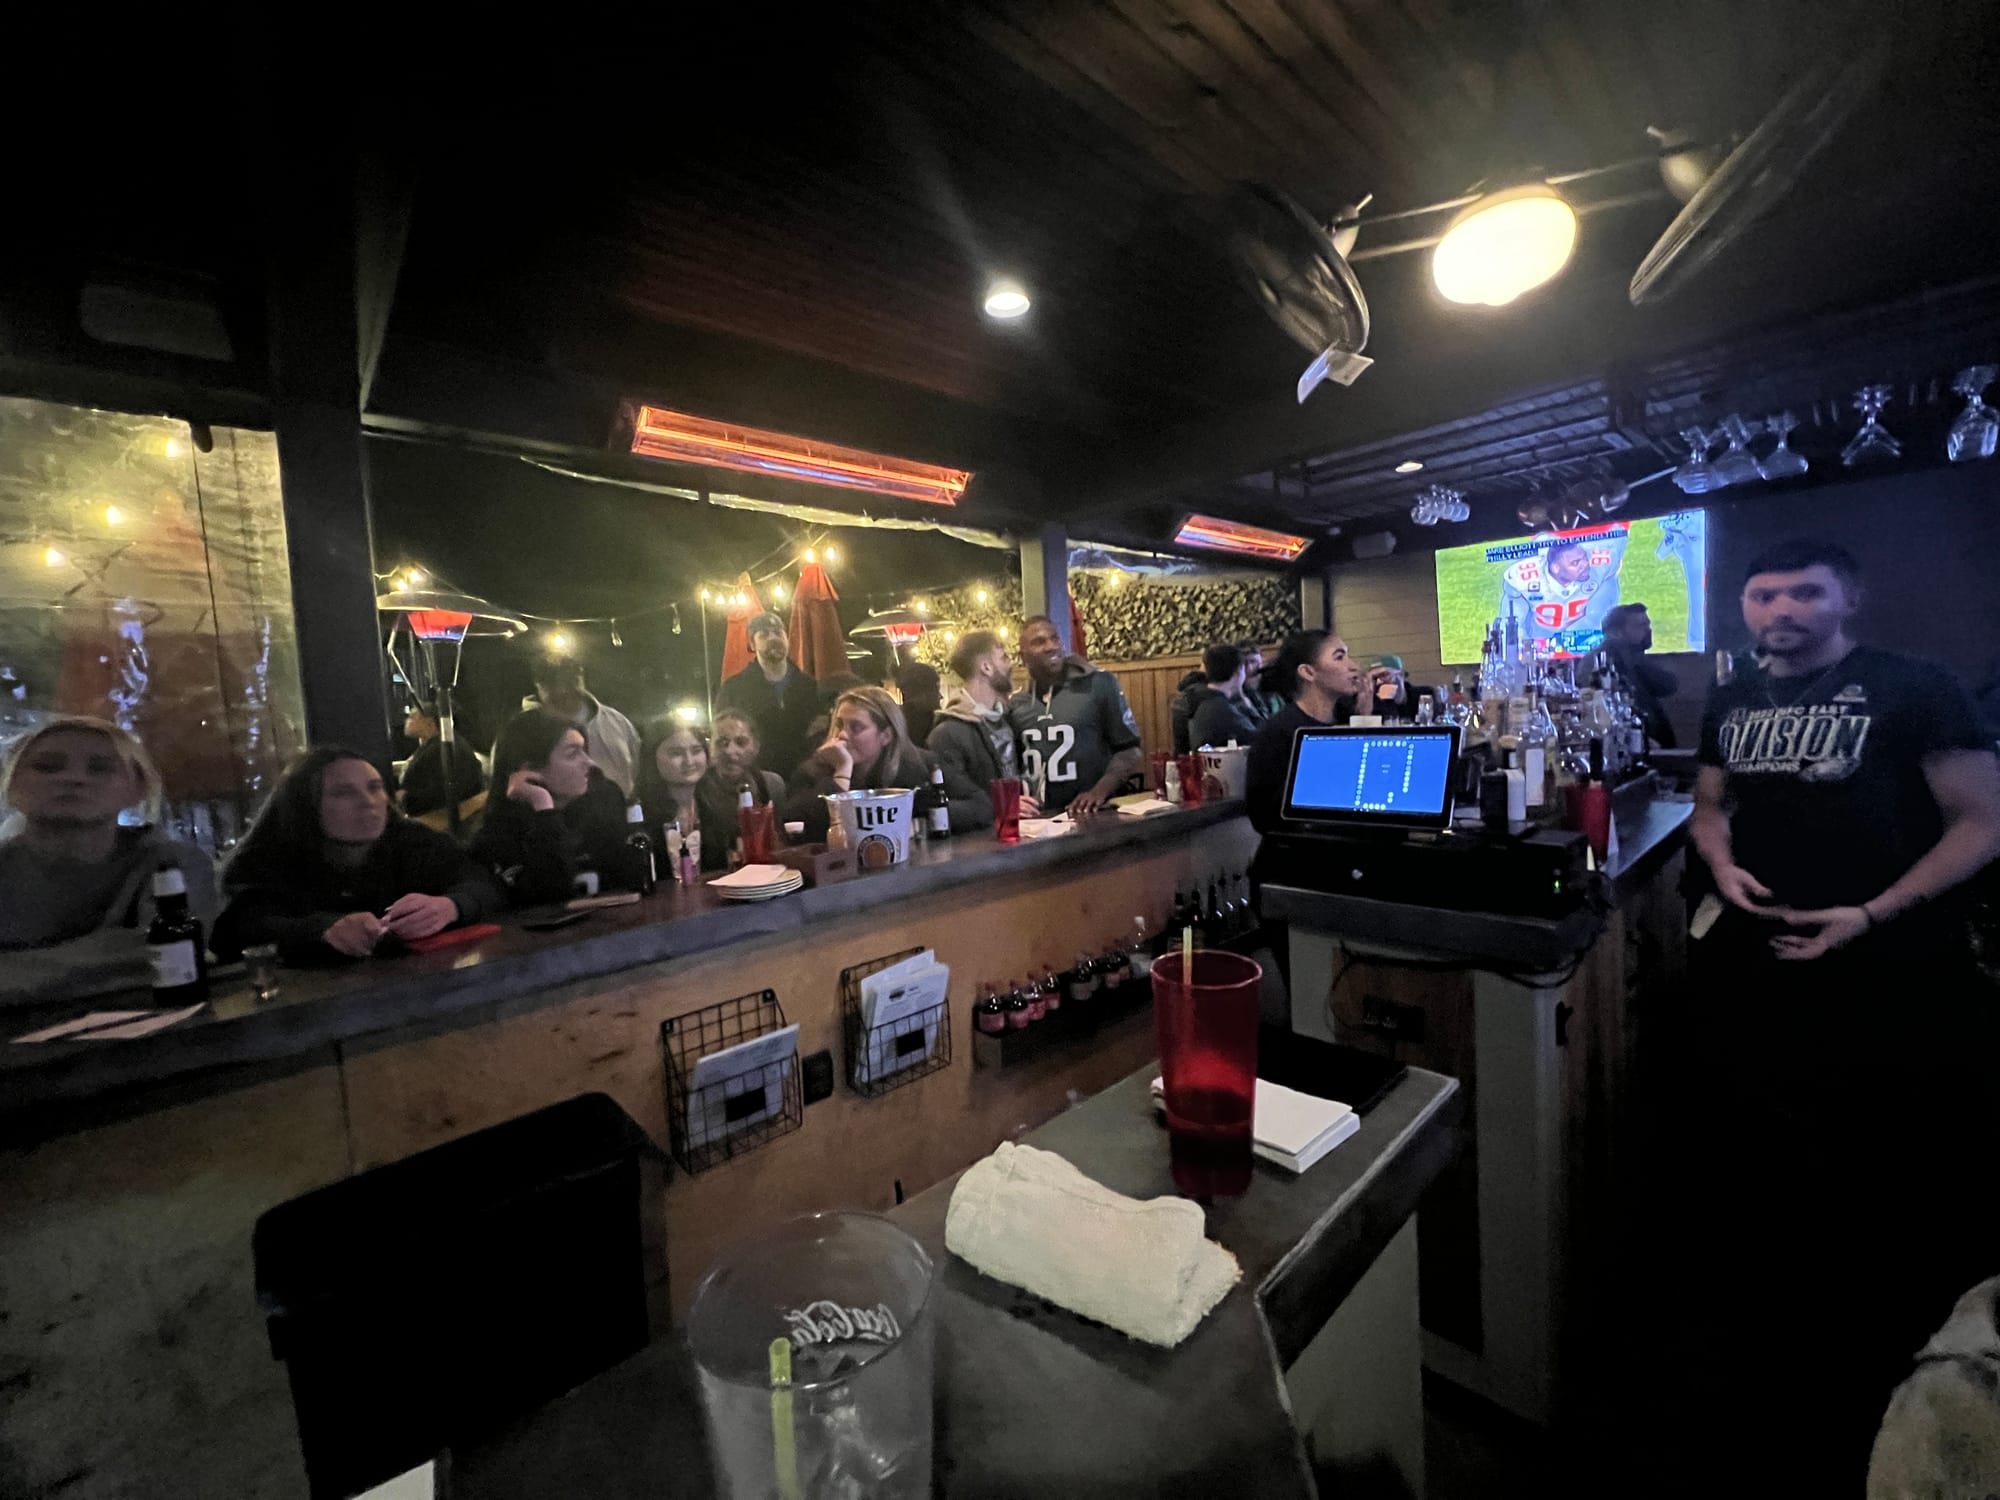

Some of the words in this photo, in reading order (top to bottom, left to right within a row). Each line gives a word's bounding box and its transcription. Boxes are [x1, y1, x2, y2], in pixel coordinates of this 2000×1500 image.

[1809, 705, 1848, 715] EAST
[1022, 724, 1077, 782] 62
[855, 806, 898, 831] Lite
